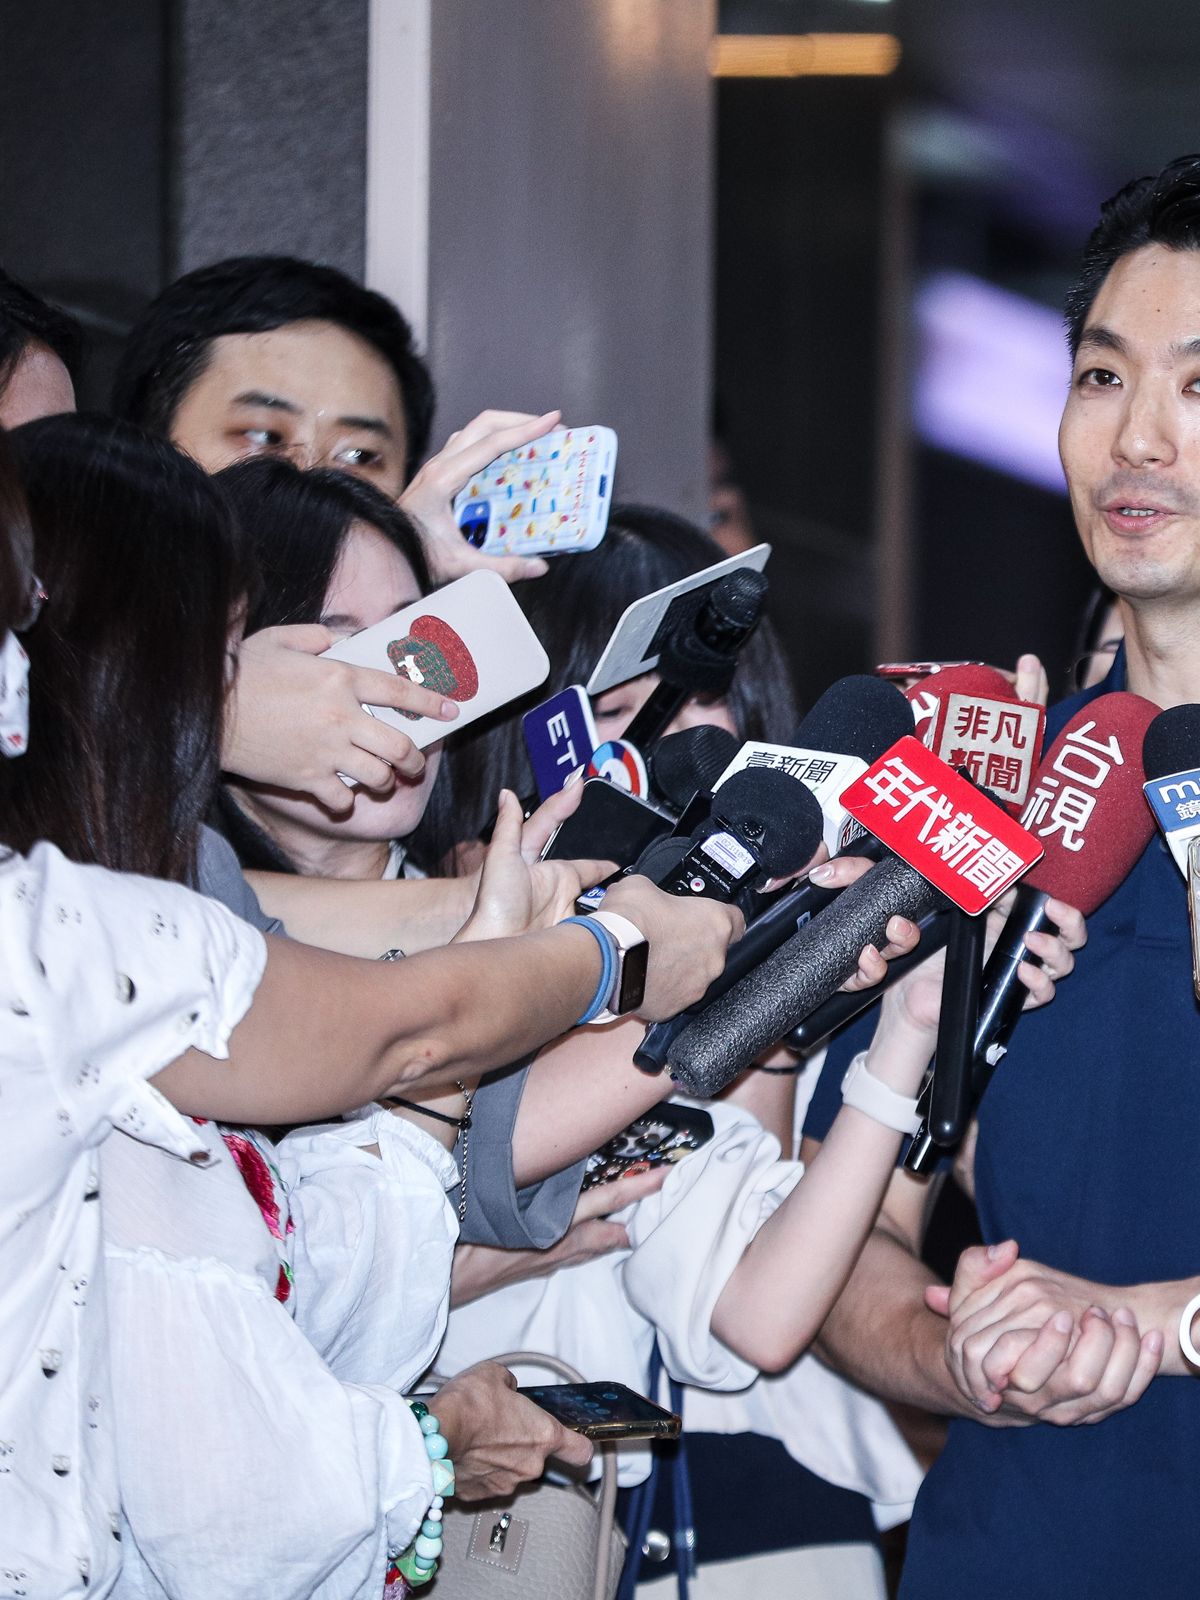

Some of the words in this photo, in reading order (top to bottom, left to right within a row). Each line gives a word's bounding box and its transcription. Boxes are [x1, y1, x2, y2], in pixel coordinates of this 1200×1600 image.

[948, 747, 1024, 795] 新聞
[953, 704, 1027, 750] 非凡
[863, 756, 1026, 899] 年代新聞
[1020, 720, 1125, 852] 台視
